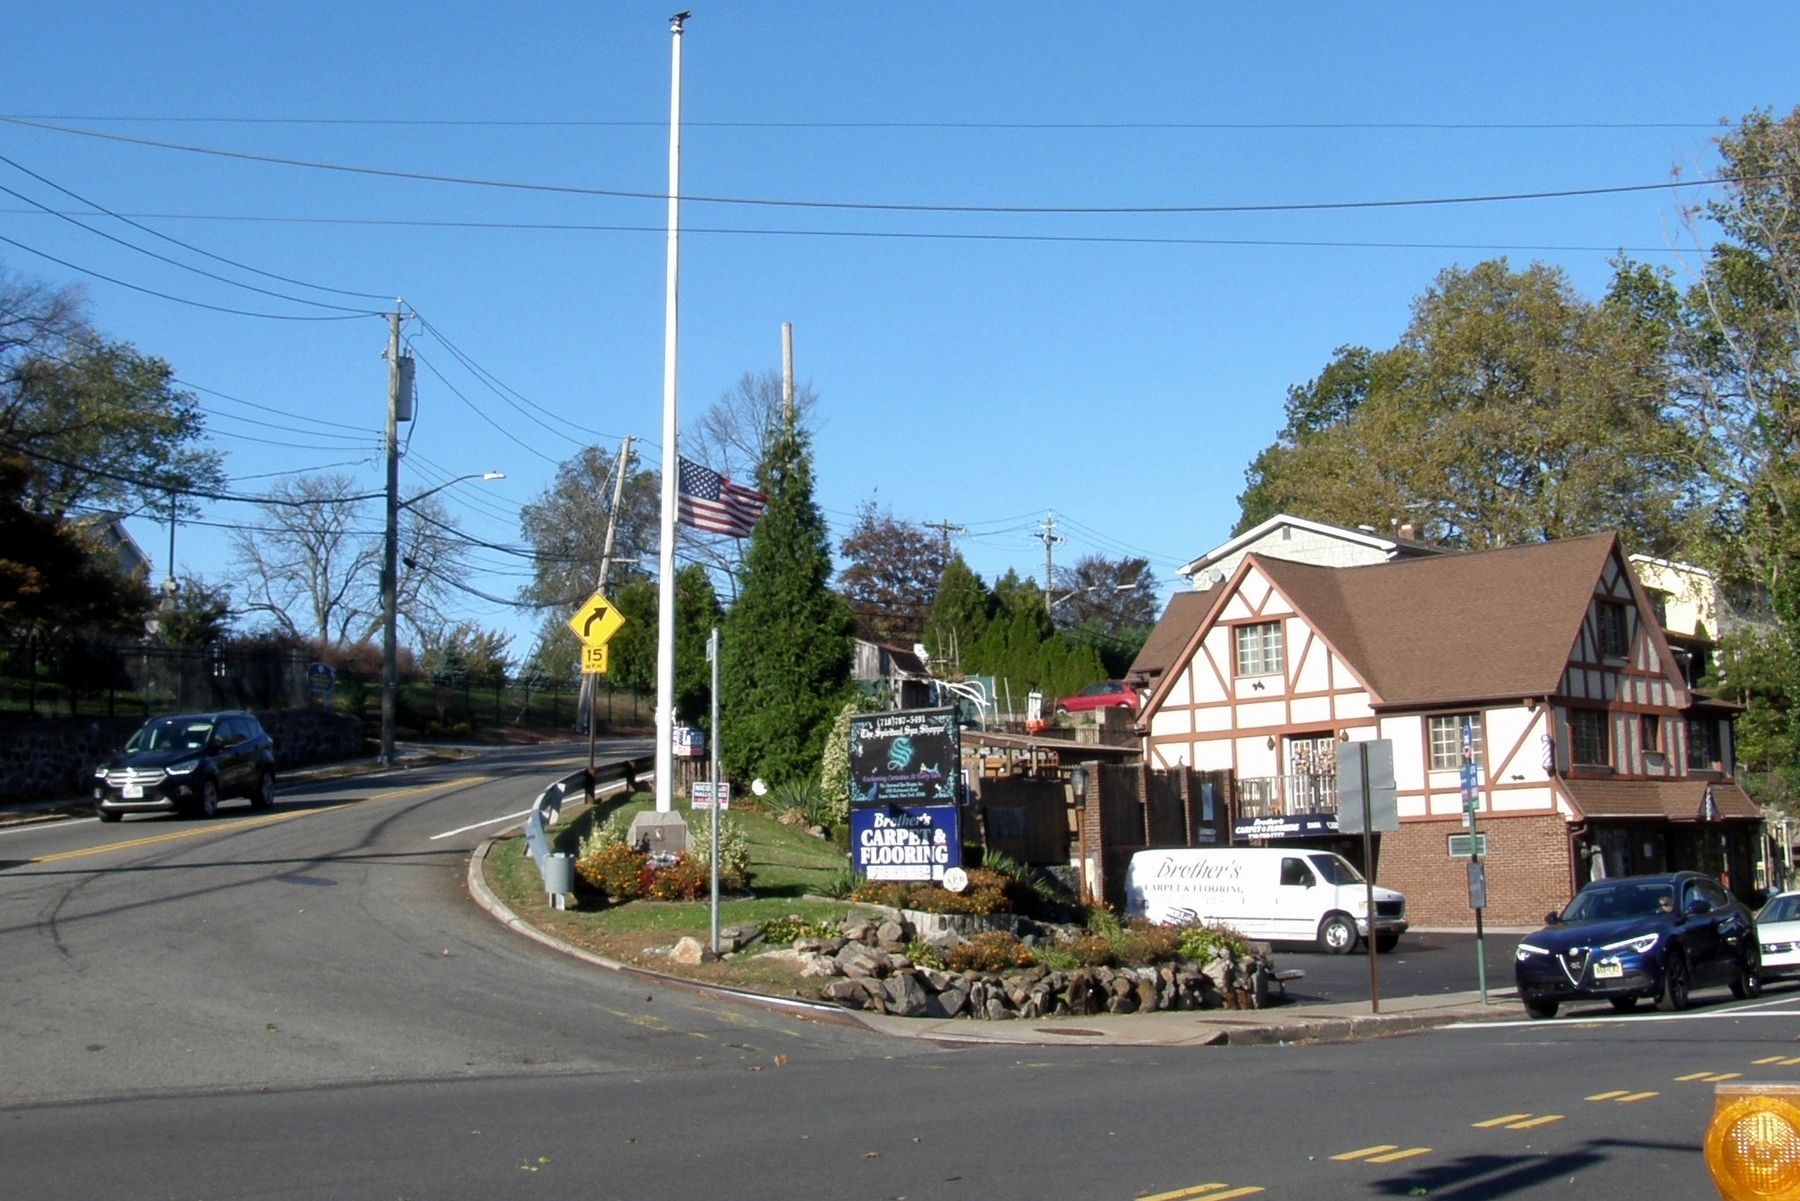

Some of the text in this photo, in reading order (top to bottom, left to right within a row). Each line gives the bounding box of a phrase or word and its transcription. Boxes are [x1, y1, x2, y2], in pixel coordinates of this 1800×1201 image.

[587, 648, 602, 661] 15
[860, 728, 873, 739] The
[874, 727, 904, 739] Spiritual
[904, 725, 918, 737] Spa
[874, 812, 931, 828] Brother's
[861, 828, 946, 846] CARPET &
[1235, 825, 1261, 834] CARPET
[860, 846, 949, 864] FLOORING
[1157, 857, 1242, 879] Brother's
[1145, 884, 1180, 892] CARPET
[1193, 885, 1244, 893] FLOORING
